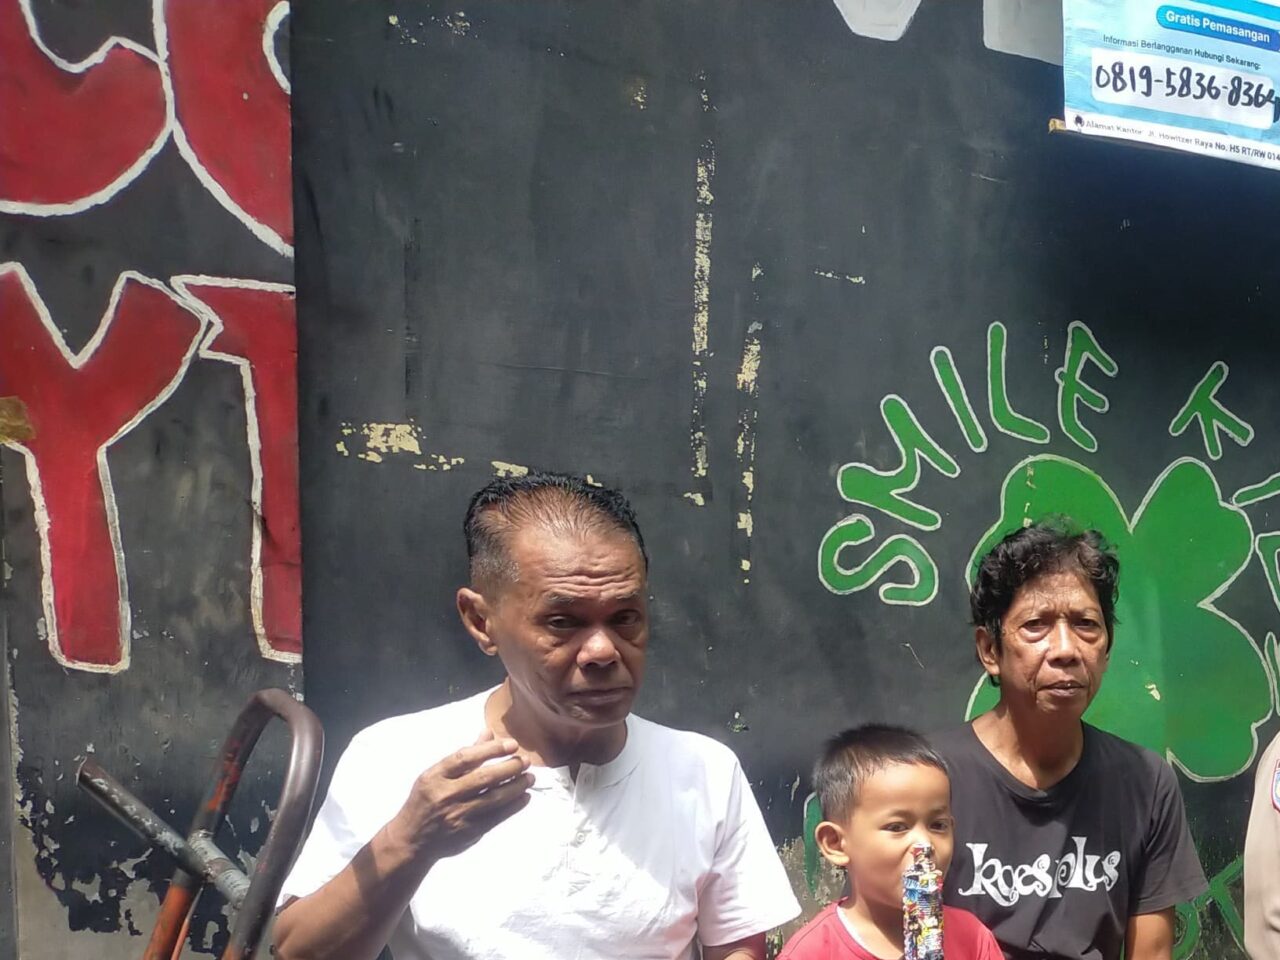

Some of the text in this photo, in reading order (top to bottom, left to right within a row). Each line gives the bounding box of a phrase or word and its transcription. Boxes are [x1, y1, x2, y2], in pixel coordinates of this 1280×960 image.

[1165, 10, 1270, 43] Gratis Pemasangan
[1103, 34, 1261, 70] Informasi Berlangganan Hubungi Sekarang:
[1085, 119, 1115, 131] Alamat
[1159, 133, 1193, 144] Howitzer
[1194, 138, 1213, 149] Raya
[1241, 147, 1266, 159] RT/RW
[818, 321, 1118, 606] SMILE
